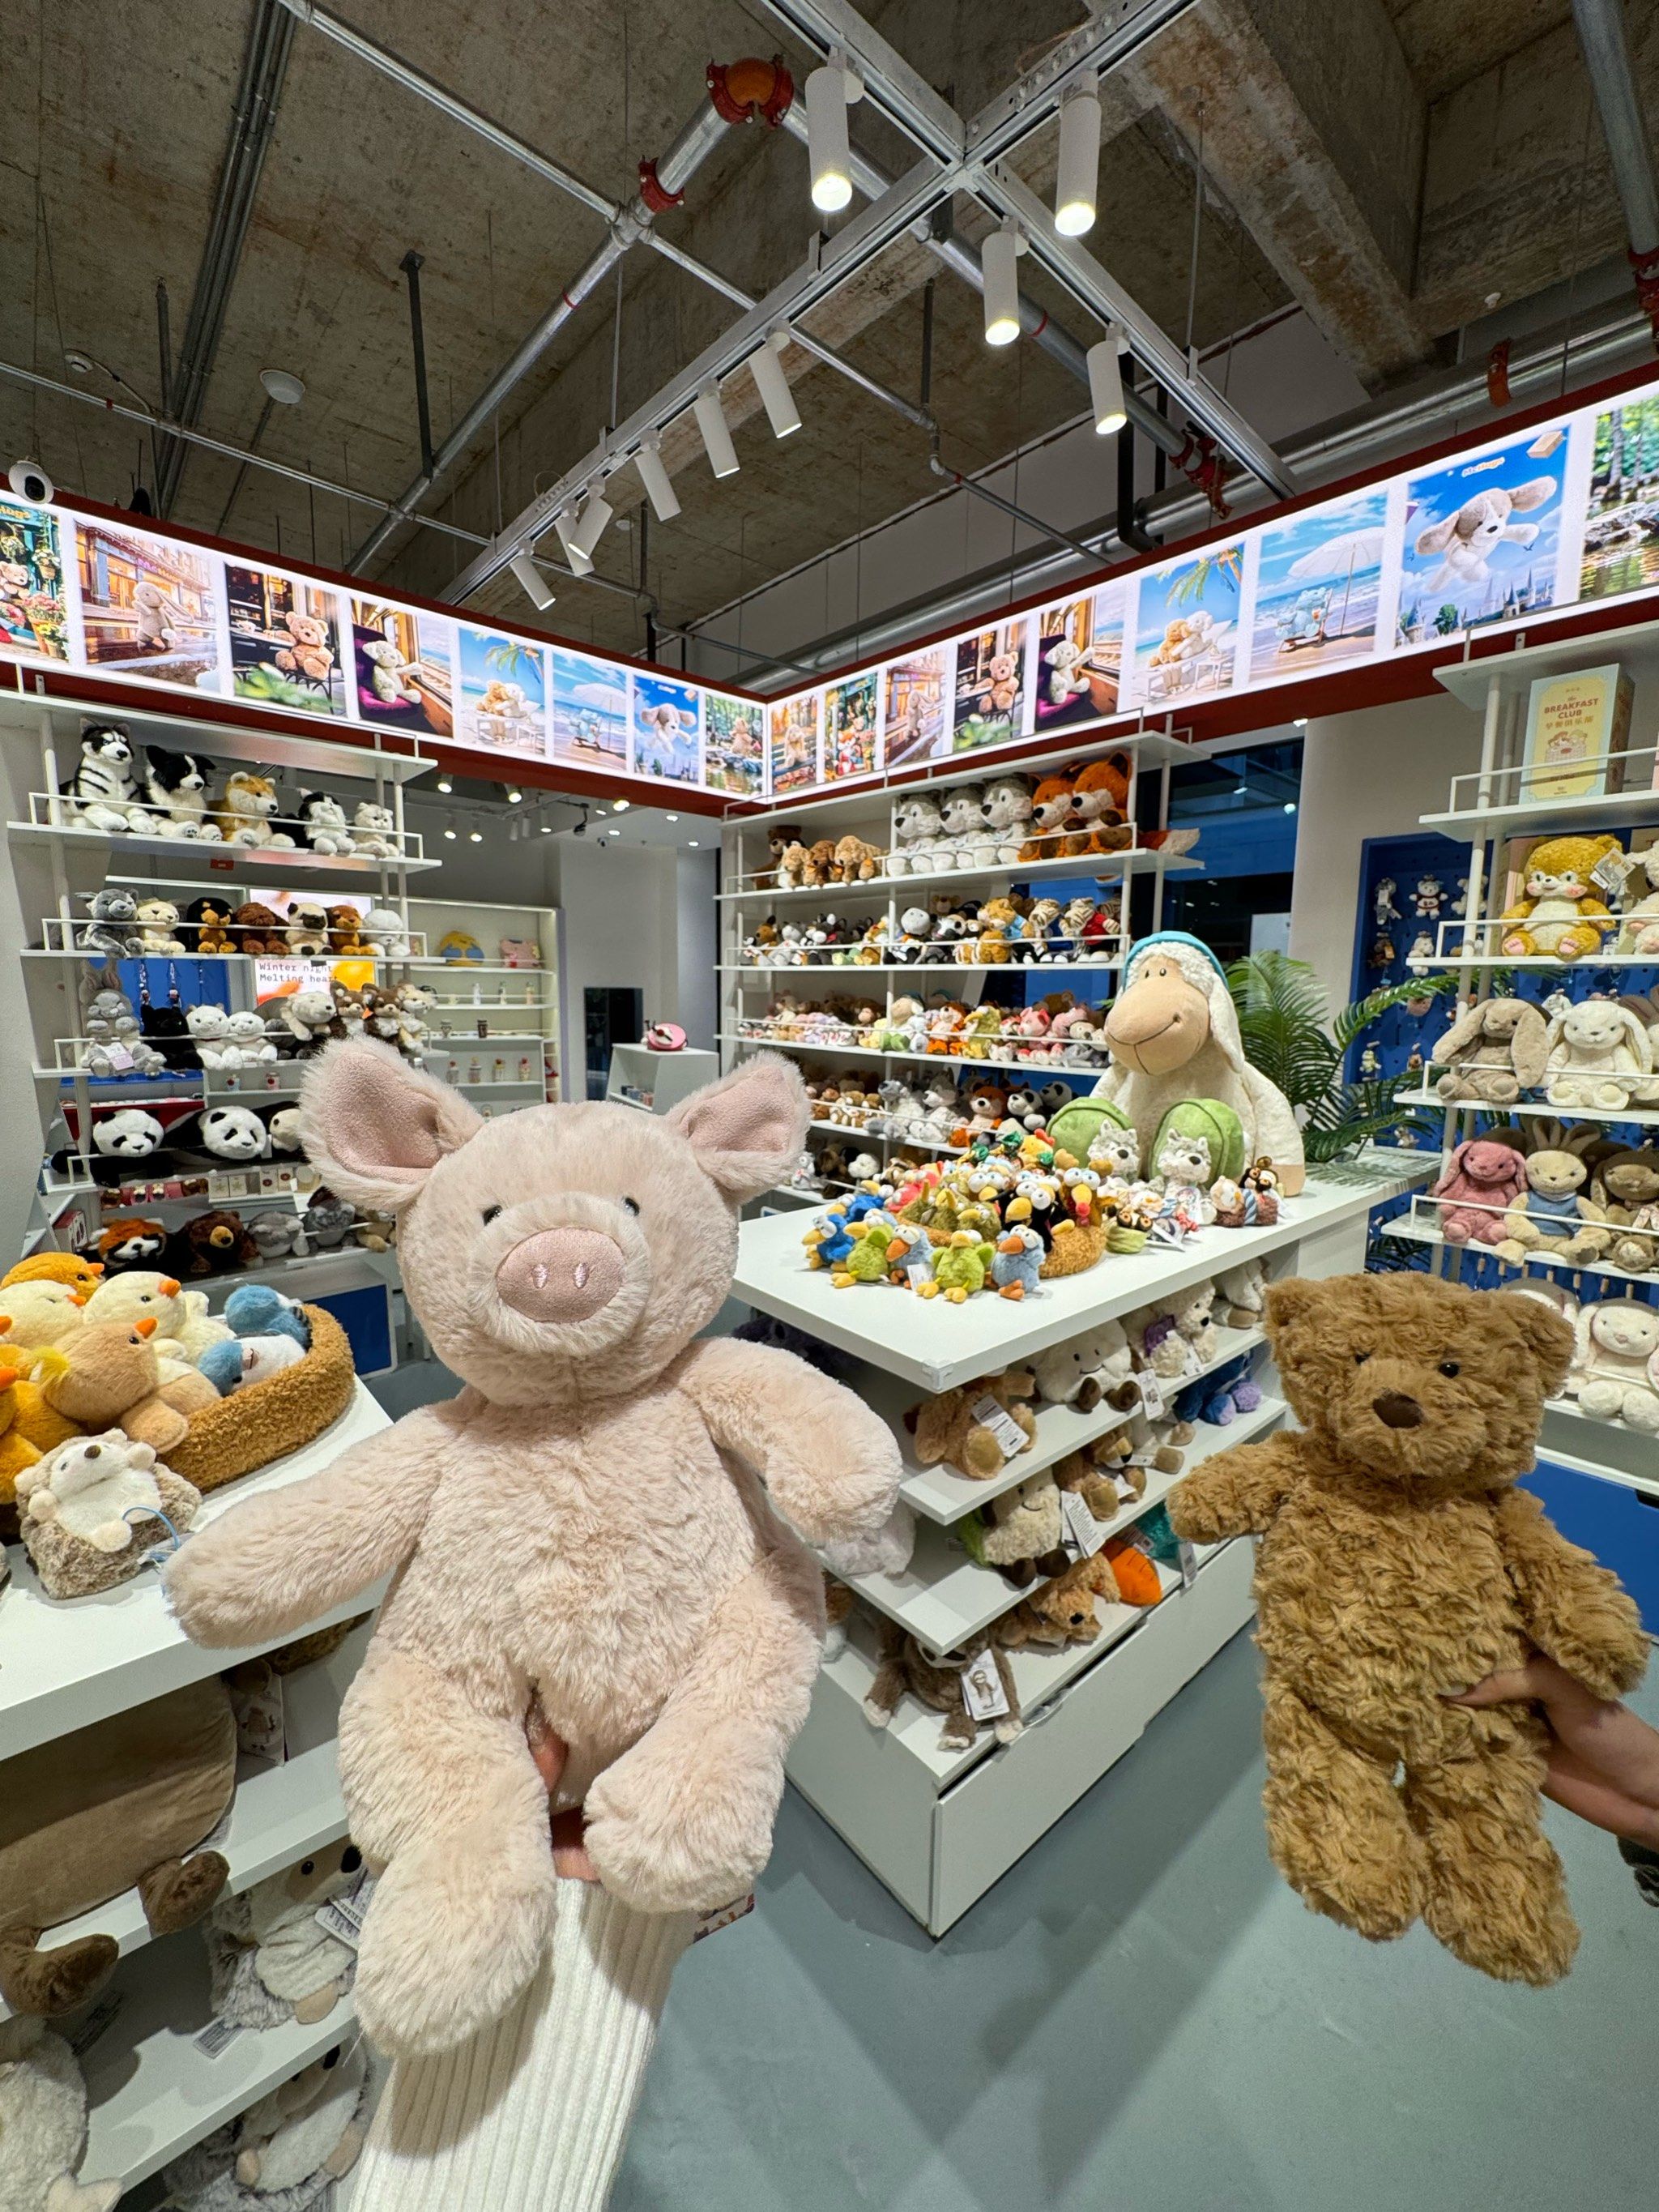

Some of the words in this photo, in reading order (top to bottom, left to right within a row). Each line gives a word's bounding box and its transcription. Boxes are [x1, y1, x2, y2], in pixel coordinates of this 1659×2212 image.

[1544, 698, 1599, 714] BREAKFAST
[1558, 709, 1583, 720] CLUB
[259, 963, 297, 971] Winter
[259, 975, 304, 984] Melting
